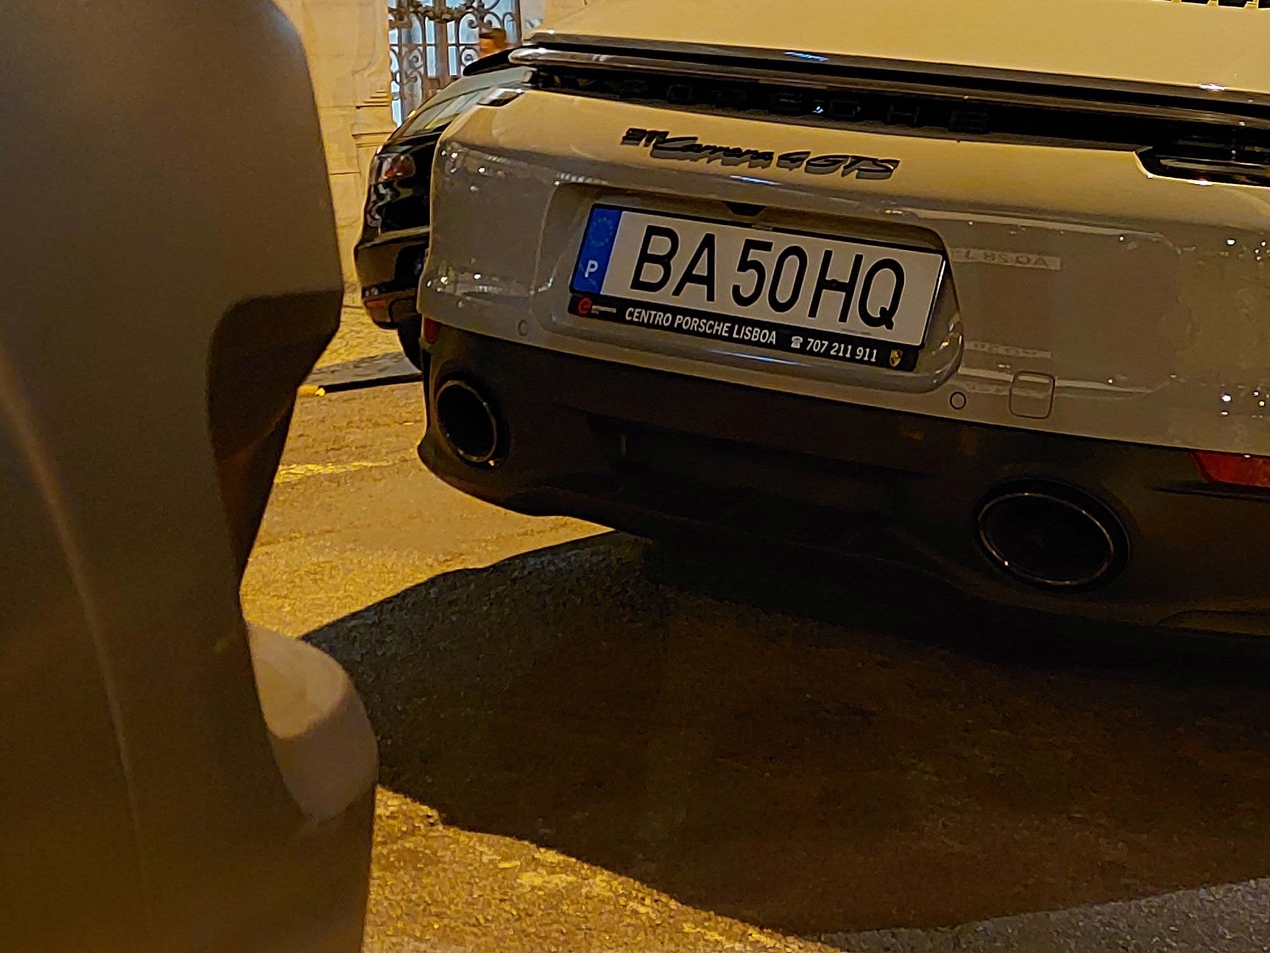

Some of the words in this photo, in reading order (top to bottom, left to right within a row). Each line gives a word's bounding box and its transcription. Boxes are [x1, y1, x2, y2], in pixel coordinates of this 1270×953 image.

[651, 136, 775, 169] Carrera
[804, 154, 900, 180] GTS
[584, 260, 598, 278] P
[630, 225, 717, 303] BA
[731, 240, 808, 314] 50
[808, 248, 906, 331] HQ
[624, 307, 673, 327] CENTRO
[673, 315, 730, 337] PORSCHE
[732, 324, 777, 346] LISBOA
[805, 337, 830, 352] 707
[832, 341, 853, 358] 211
[855, 345, 878, 363] 911
